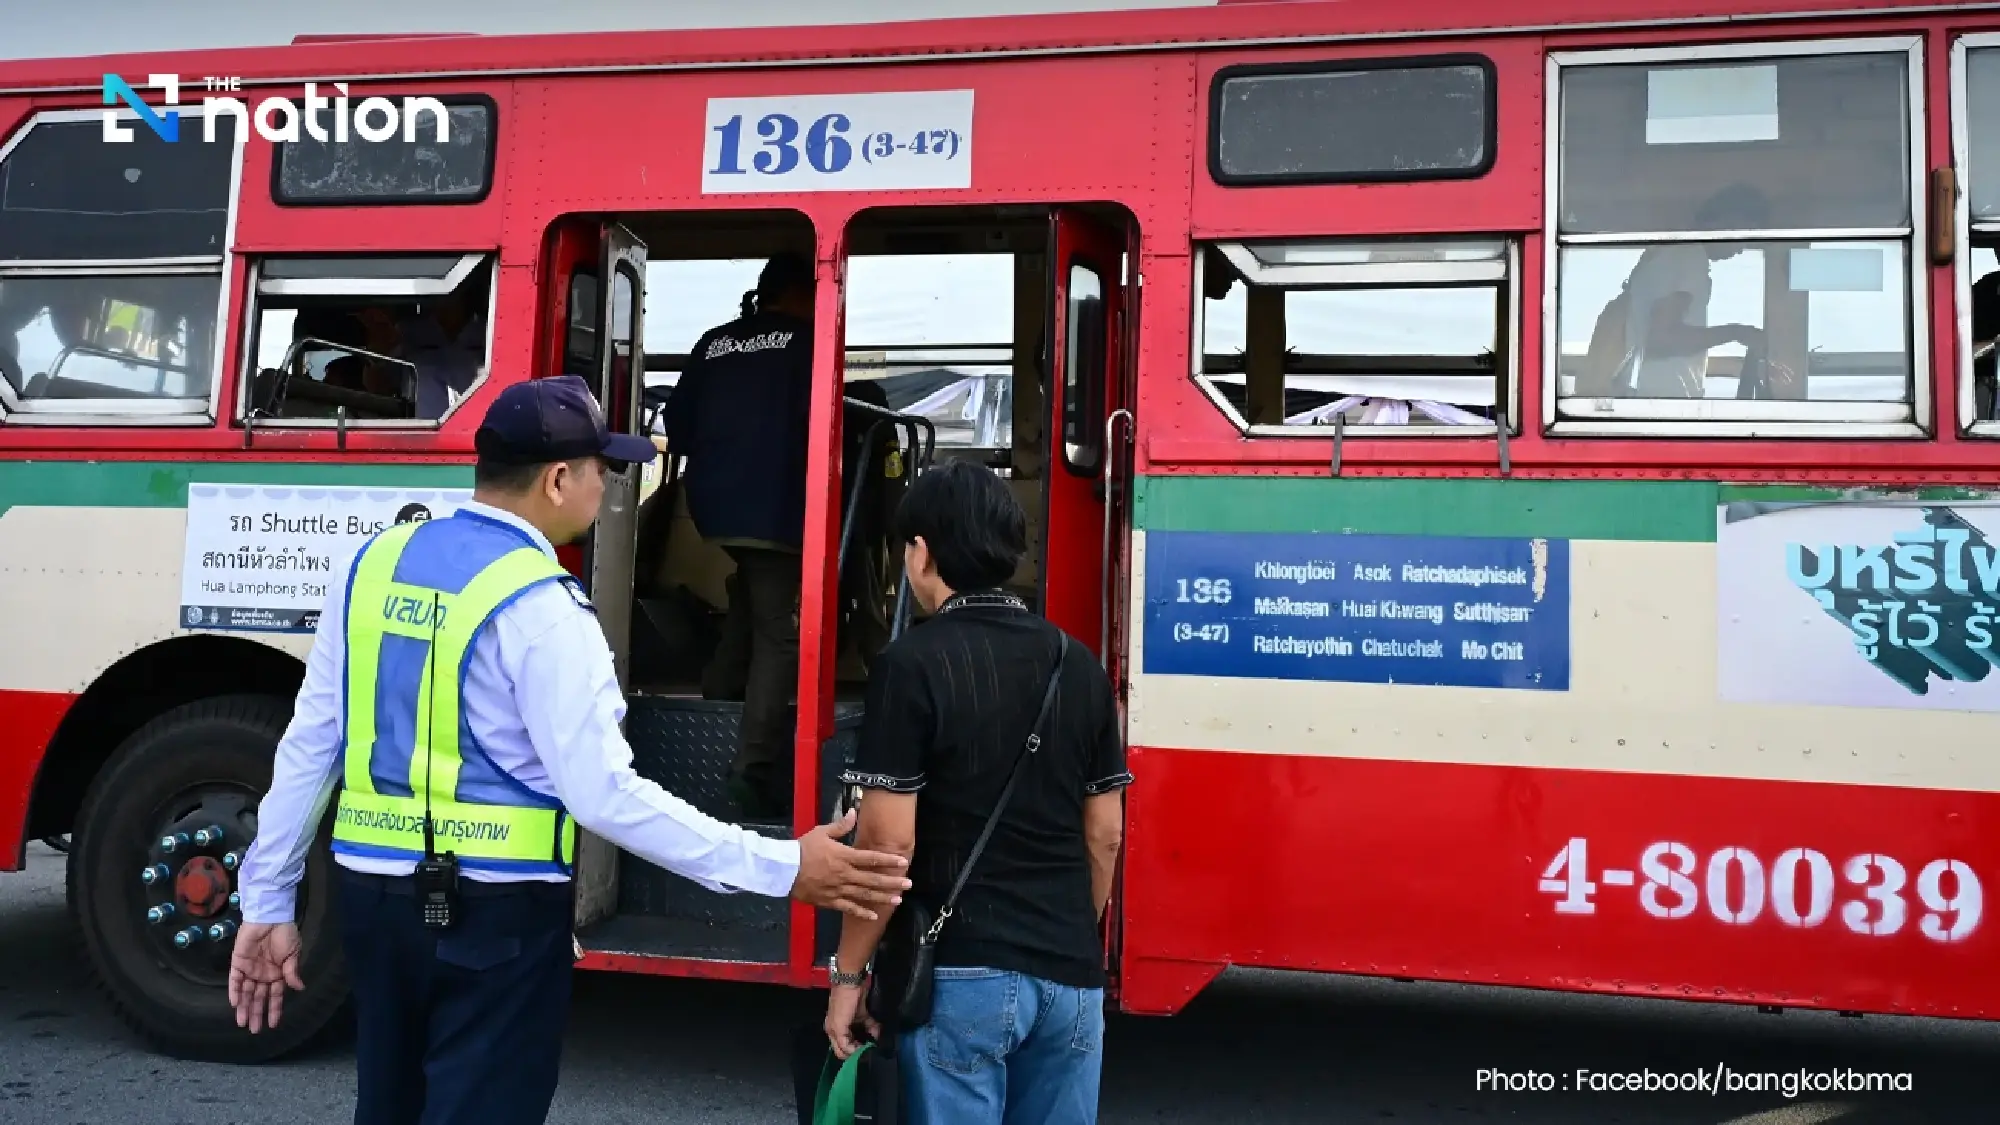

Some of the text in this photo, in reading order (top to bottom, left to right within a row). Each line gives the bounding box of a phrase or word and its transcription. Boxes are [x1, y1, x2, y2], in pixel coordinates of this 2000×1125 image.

[709, 113, 962, 175] 136 (3-47)
[230, 512, 383, 536] รถ Shuttle Bus
[202, 545, 330, 572] สถานีหัวลำโพง
[1254, 561, 1527, 587] Khlongtoei Asok Ratchadaphisek
[201, 580, 329, 598] Hua Lamphong Stat
[1176, 577, 1232, 603] 136
[1342, 600, 1377, 618] Huai
[1380, 601, 1444, 625] Khwang
[1173, 623, 1229, 643] (3-47)
[1852, 599, 1942, 661] รู้ไว้
[1254, 635, 1524, 661] Ratchayothin Chatuchak Mo Chit
[1538, 836, 1984, 943] 4-80039
